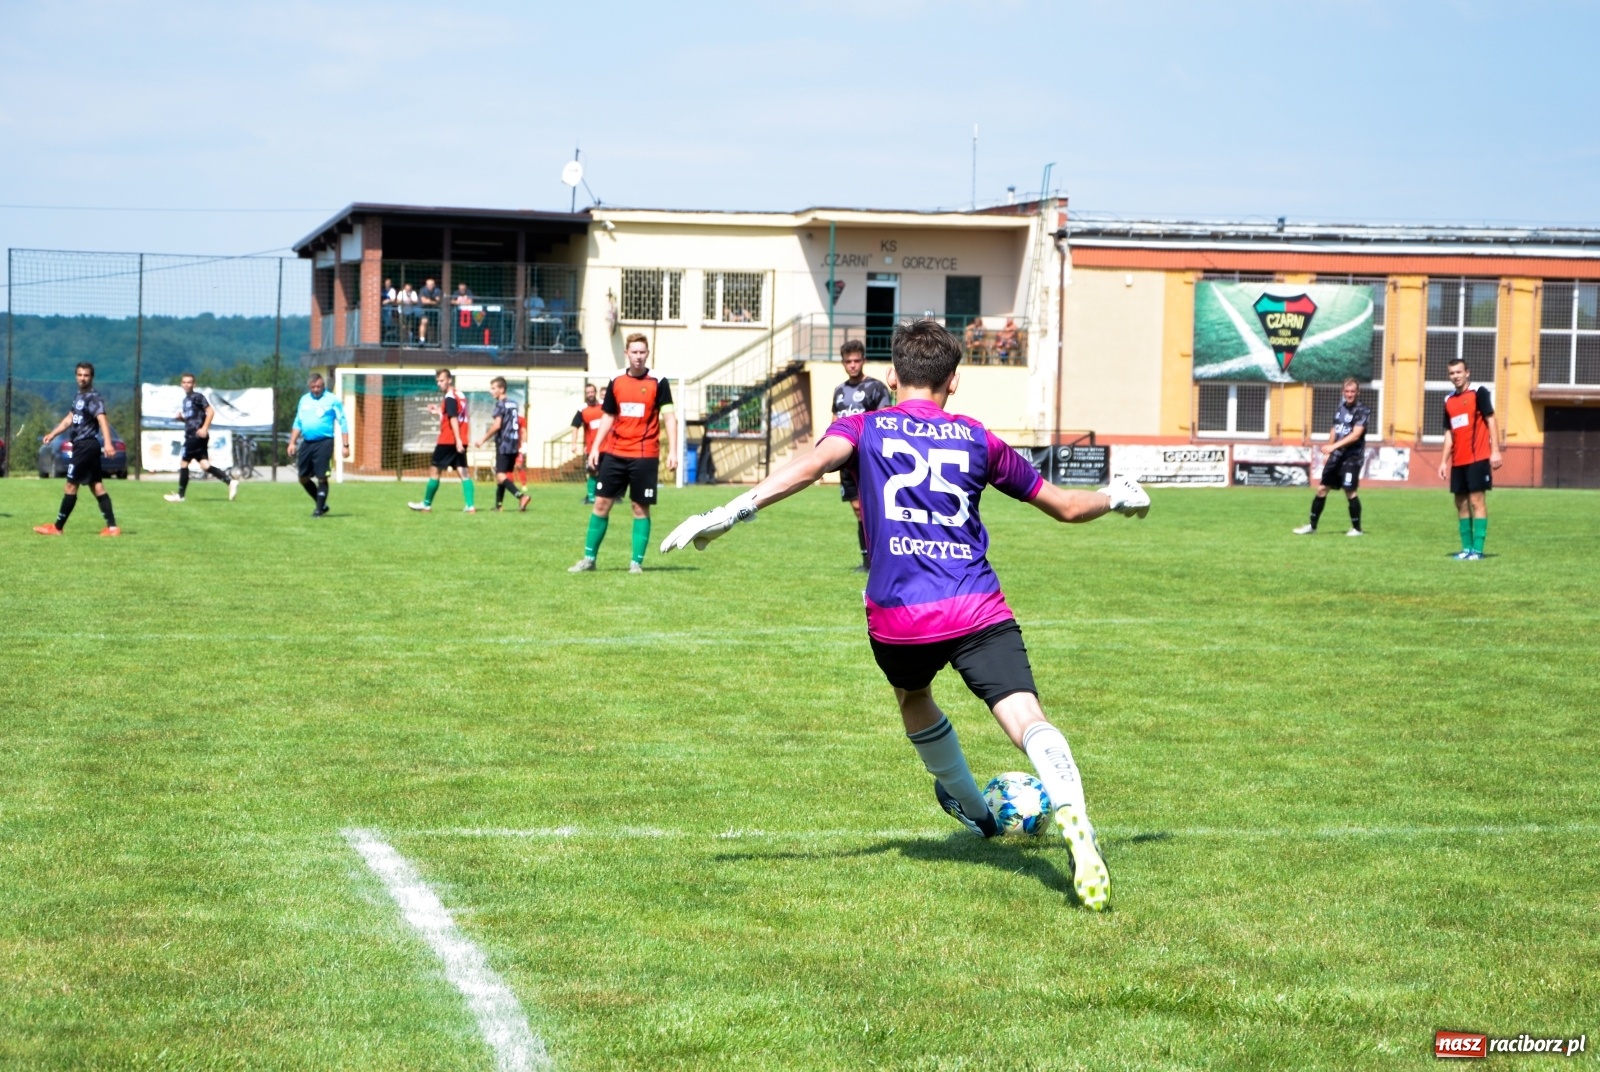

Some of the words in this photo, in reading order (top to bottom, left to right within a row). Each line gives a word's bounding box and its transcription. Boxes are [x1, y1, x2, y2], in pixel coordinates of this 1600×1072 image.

[880, 240, 897, 253] KS
[902, 256, 958, 271] GORZYCE
[1266, 312, 1305, 330] CZARNI
[1269, 336, 1300, 346] GORZYCE
[875, 416, 898, 431] KS
[902, 418, 975, 441] CZARNI
[1164, 450, 1225, 462] GEODEZJA
[882, 437, 970, 527] 25
[889, 536, 973, 560] GORZYCE
